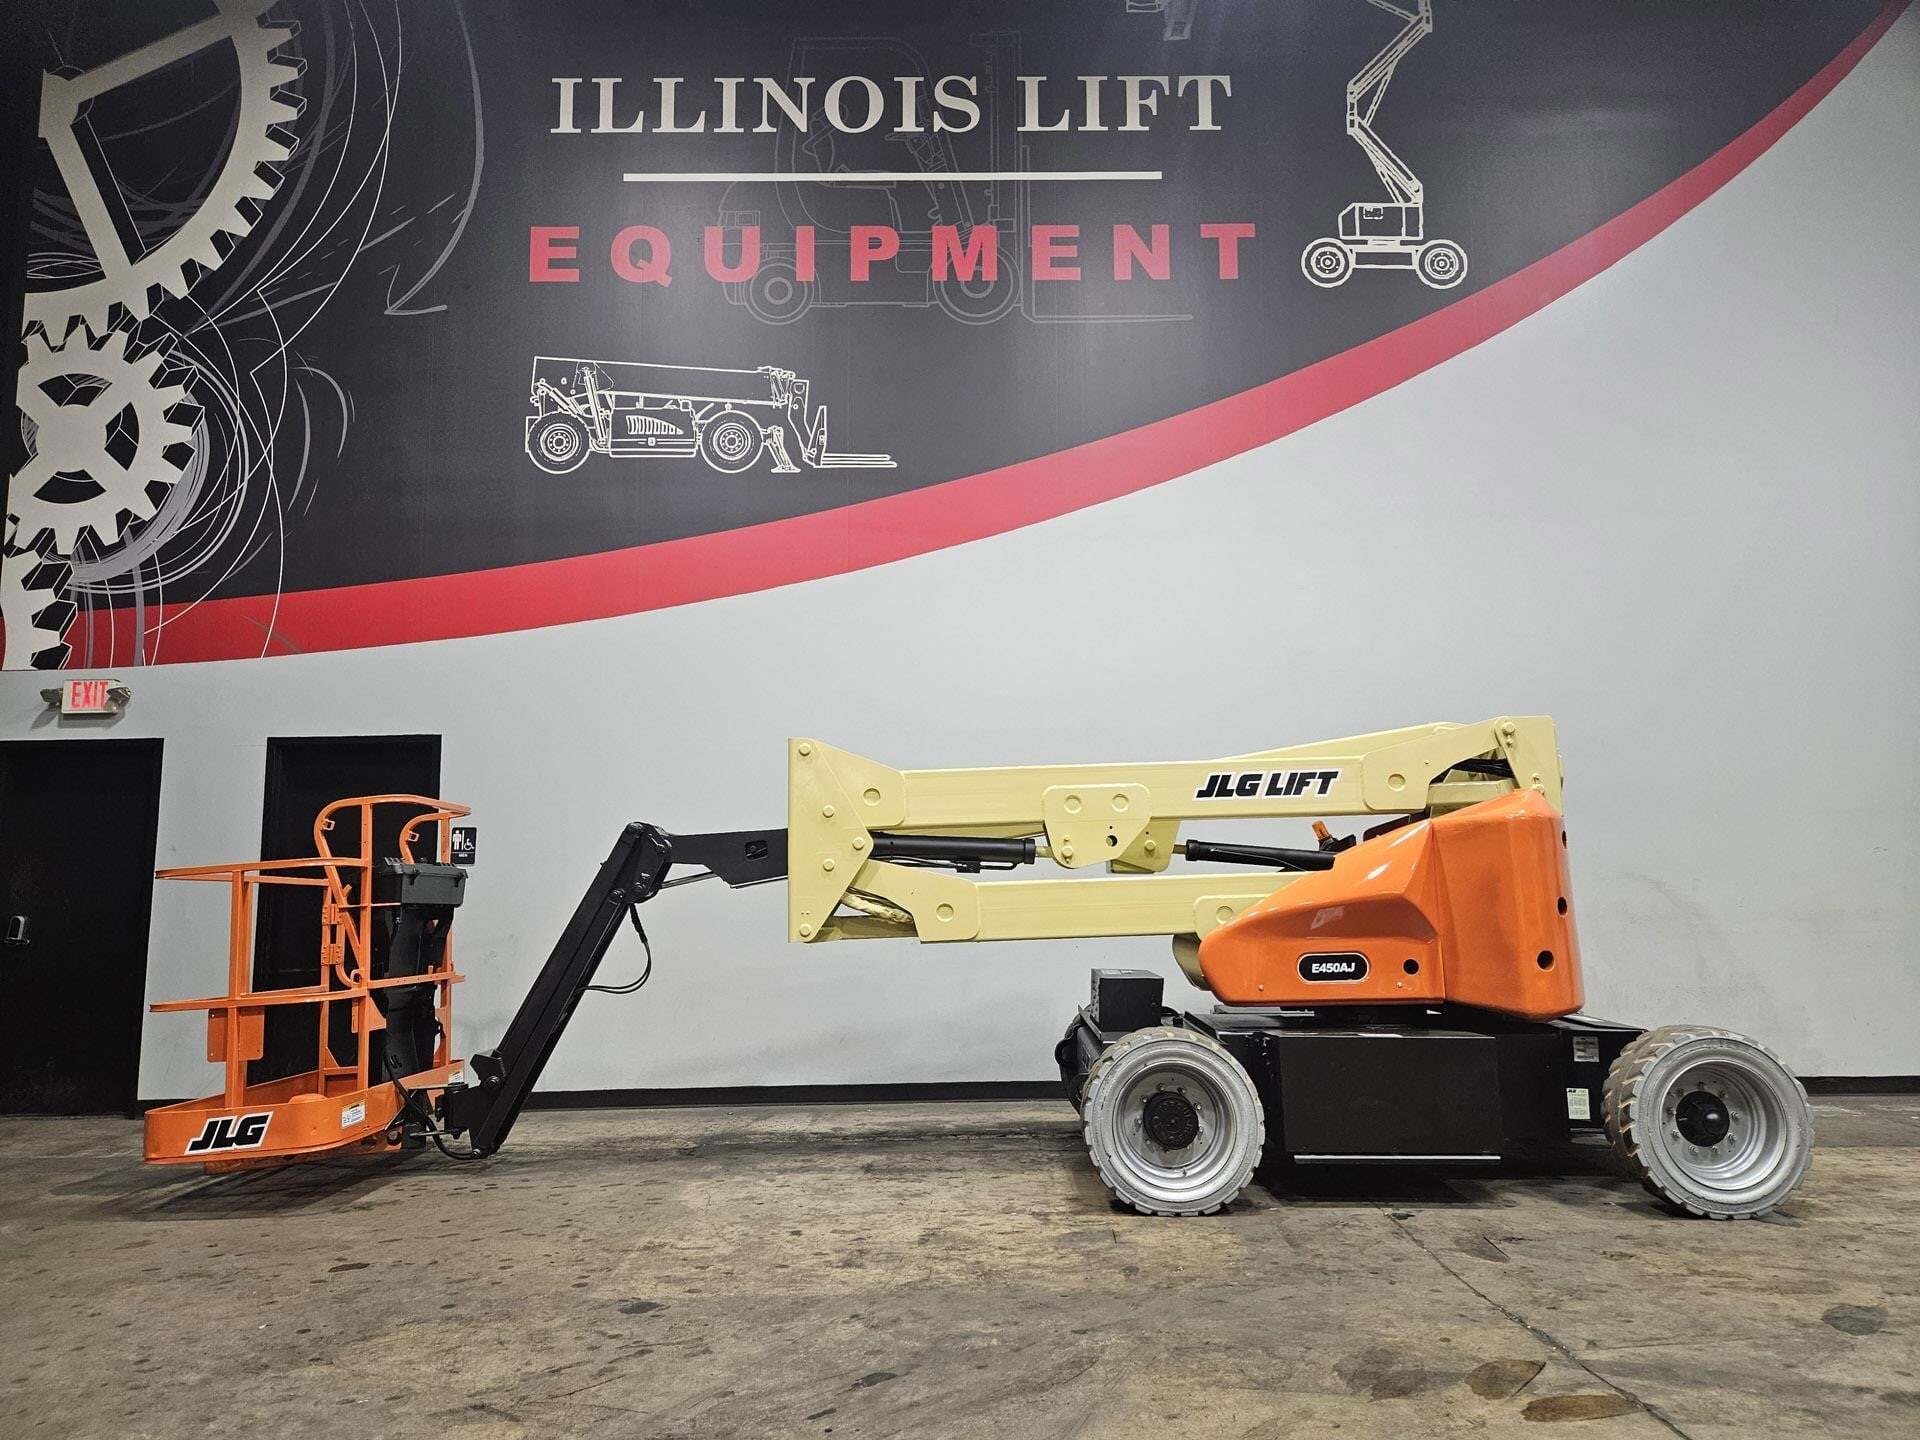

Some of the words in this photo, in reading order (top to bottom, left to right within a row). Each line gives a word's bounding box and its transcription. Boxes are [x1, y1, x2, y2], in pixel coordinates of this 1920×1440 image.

[550, 75, 981, 134] ILLINOIS
[1016, 75, 1232, 132] LIFT
[527, 222, 1256, 286] EQUIPMENT
[71, 681, 109, 708] EXIT
[1196, 773, 1263, 798] JLG
[1265, 771, 1339, 796] LIFT
[1311, 962, 1356, 974] E450AJ
[188, 1114, 270, 1152] JLG
